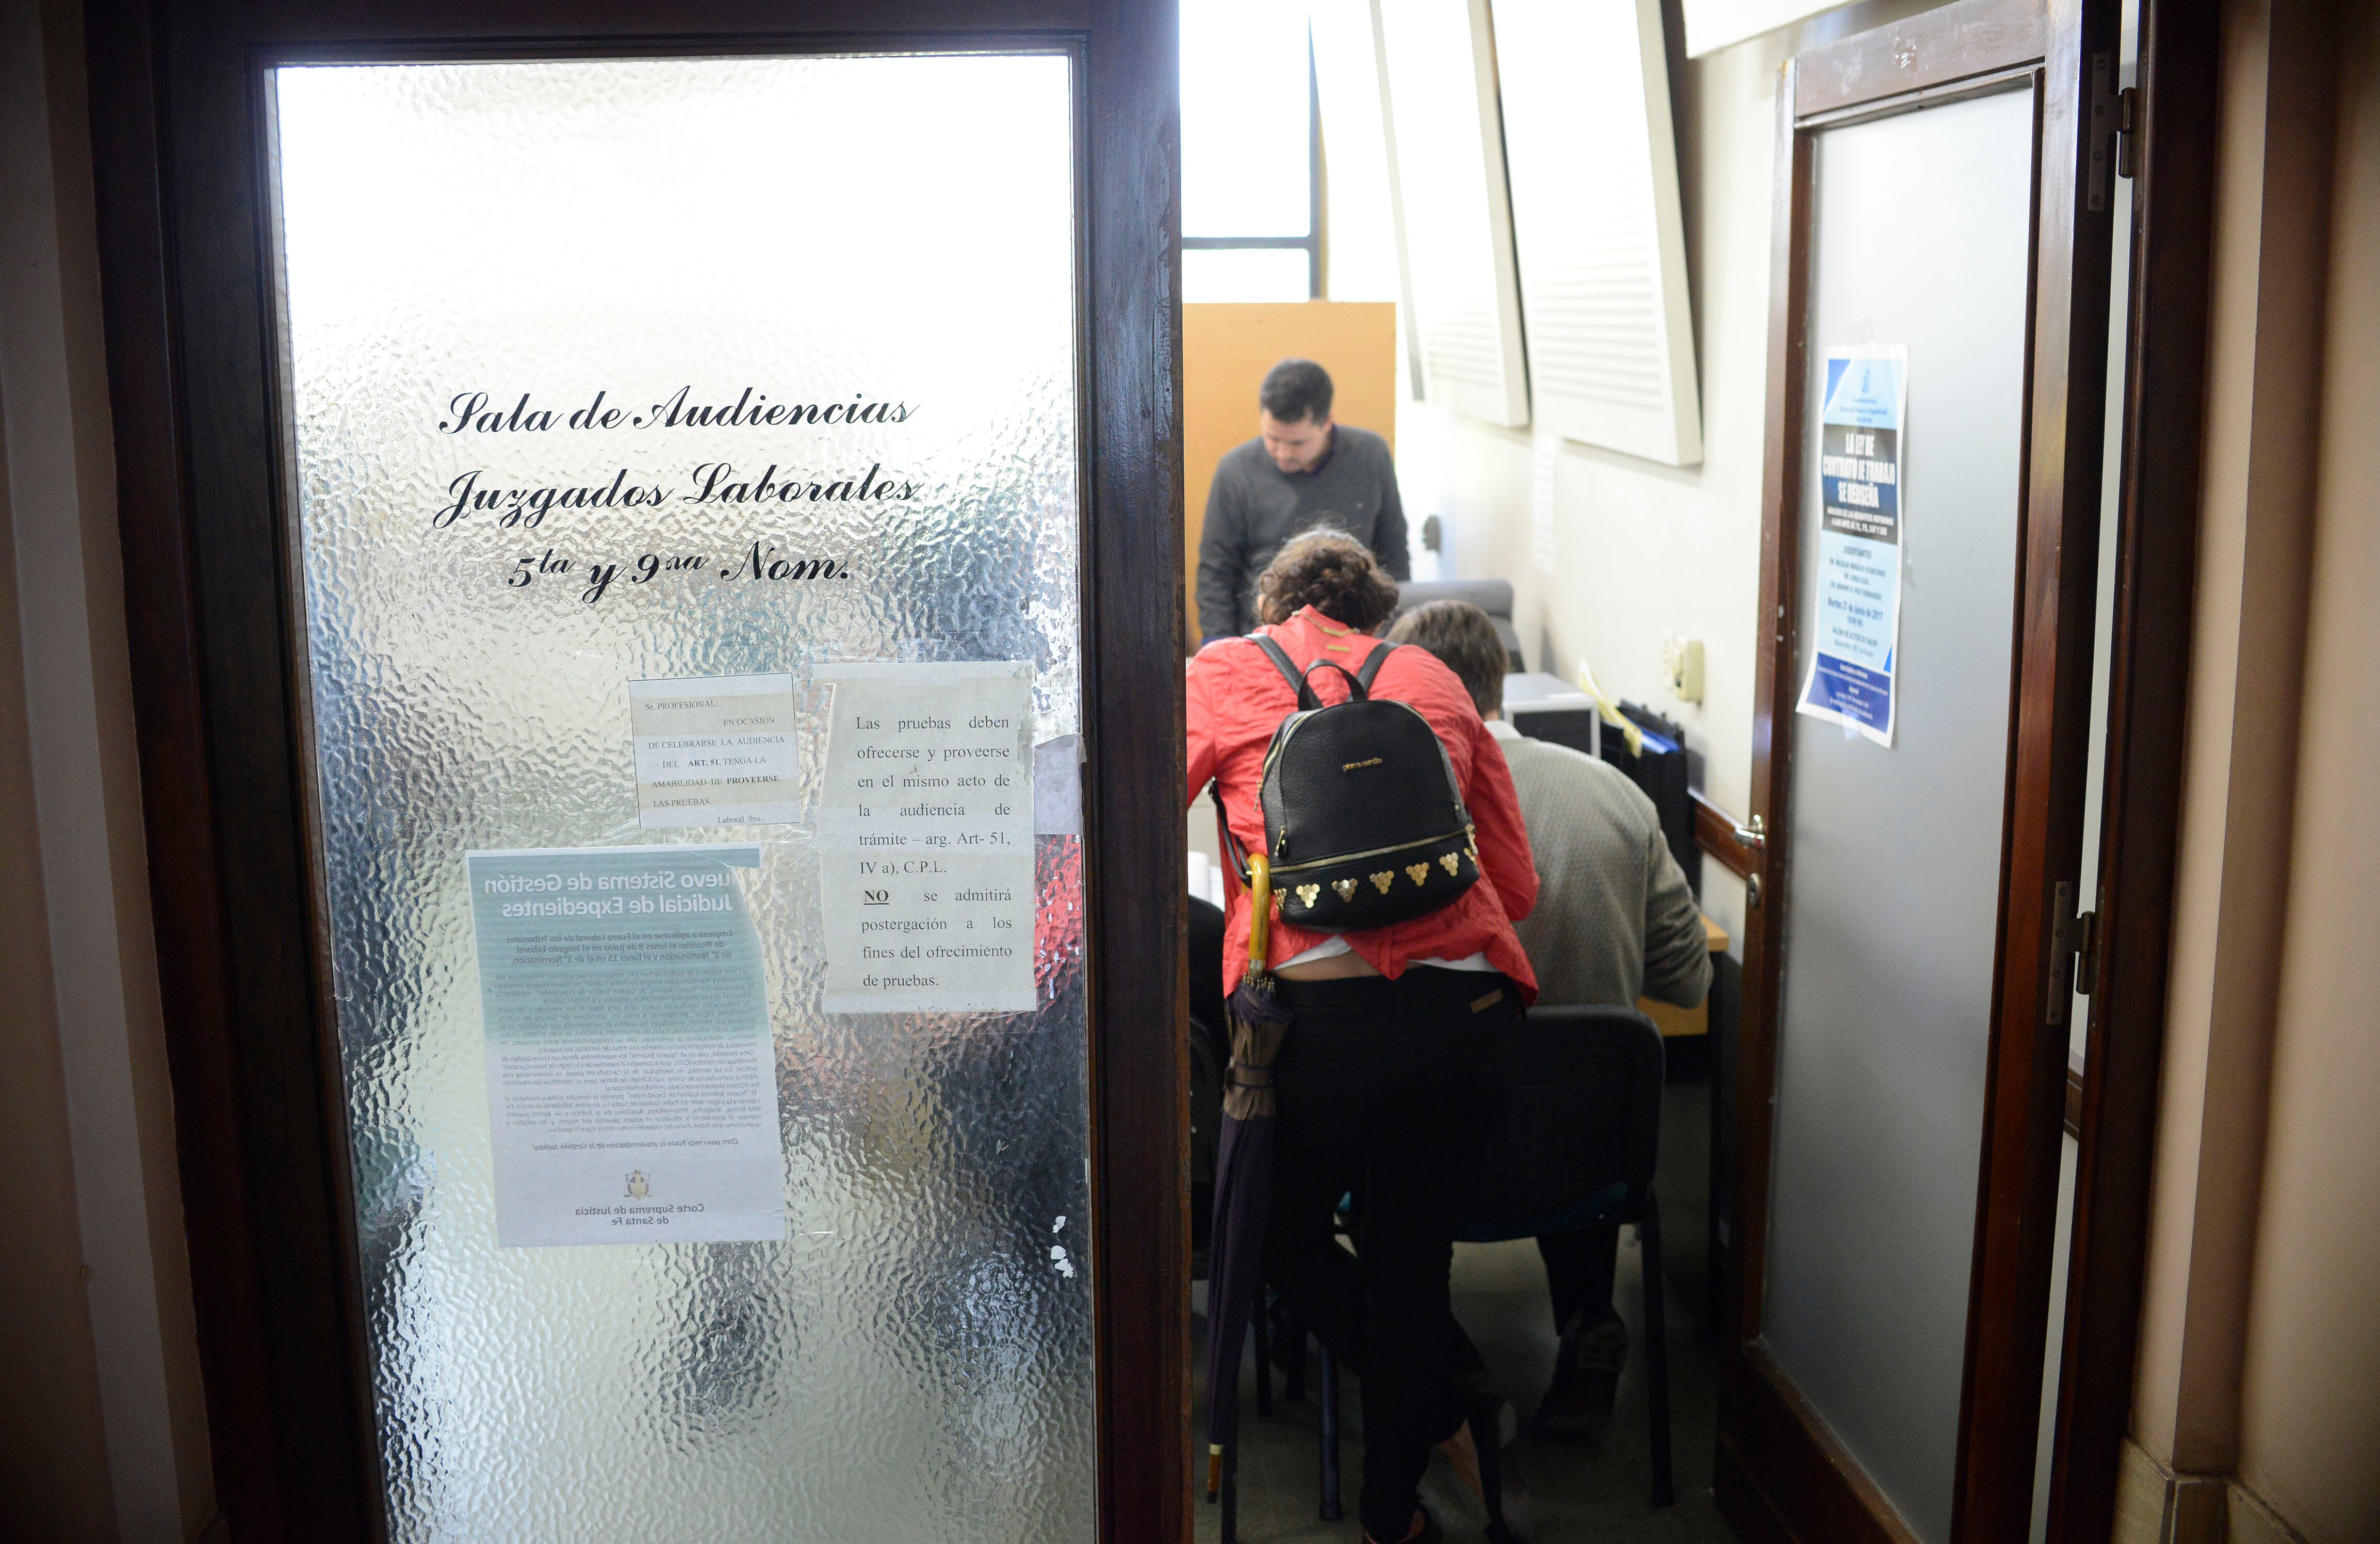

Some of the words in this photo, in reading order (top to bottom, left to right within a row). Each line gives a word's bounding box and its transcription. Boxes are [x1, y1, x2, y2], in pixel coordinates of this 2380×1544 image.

[439, 391, 563, 435] Sala
[569, 390, 632, 430] de
[634, 385, 920, 430] Audiencias
[433, 469, 674, 529] Juzgados
[683, 463, 925, 505] Laborales
[508, 548, 576, 588] 5ta
[582, 559, 627, 604] y
[721, 541, 849, 582] Nom.
[657, 701, 718, 710] PROFESIONAL:
[737, 716, 775, 725] OCASIÓN
[856, 716, 880, 730] Las
[898, 716, 951, 732] pruebas
[969, 716, 1009, 729] deben
[662, 740, 717, 748] CELEBRARSE
[737, 736, 785, 745] AUDIENCIA
[857, 746, 919, 759] ofrecerse
[927, 749, 935, 762] y
[943, 748, 1010, 761] proveerse
[651, 779, 707, 788] AMABILIDAD
[727, 775, 779, 784] PROVEERSE
[857, 777, 874, 787] en
[882, 775, 894, 787] el
[903, 776, 949, 787] mismo
[957, 777, 985, 786] acto
[994, 775, 1010, 786] de
[859, 804, 871, 816] la
[900, 803, 965, 816] audiencia
[995, 804, 1010, 816] de
[859, 832, 907, 846] trámite
[925, 835, 951, 848] arg.
[989, 834, 1010, 848] 51,
[860, 862, 876, 874] IV
[882, 862, 899, 876] a),
[904, 862, 947, 873] C.P.L.
[863, 890, 889, 901] NO
[924, 892, 938, 901] se
[955, 889, 1012, 901] admitirá
[861, 918, 947, 933] postergación
[966, 921, 973, 929] a
[992, 917, 1012, 928] los
[862, 946, 894, 958] fines
[901, 946, 921, 958] del
[926, 945, 1012, 957] ofrecimiento
[863, 975, 878, 986] de
[883, 976, 939, 989] pruebas.
